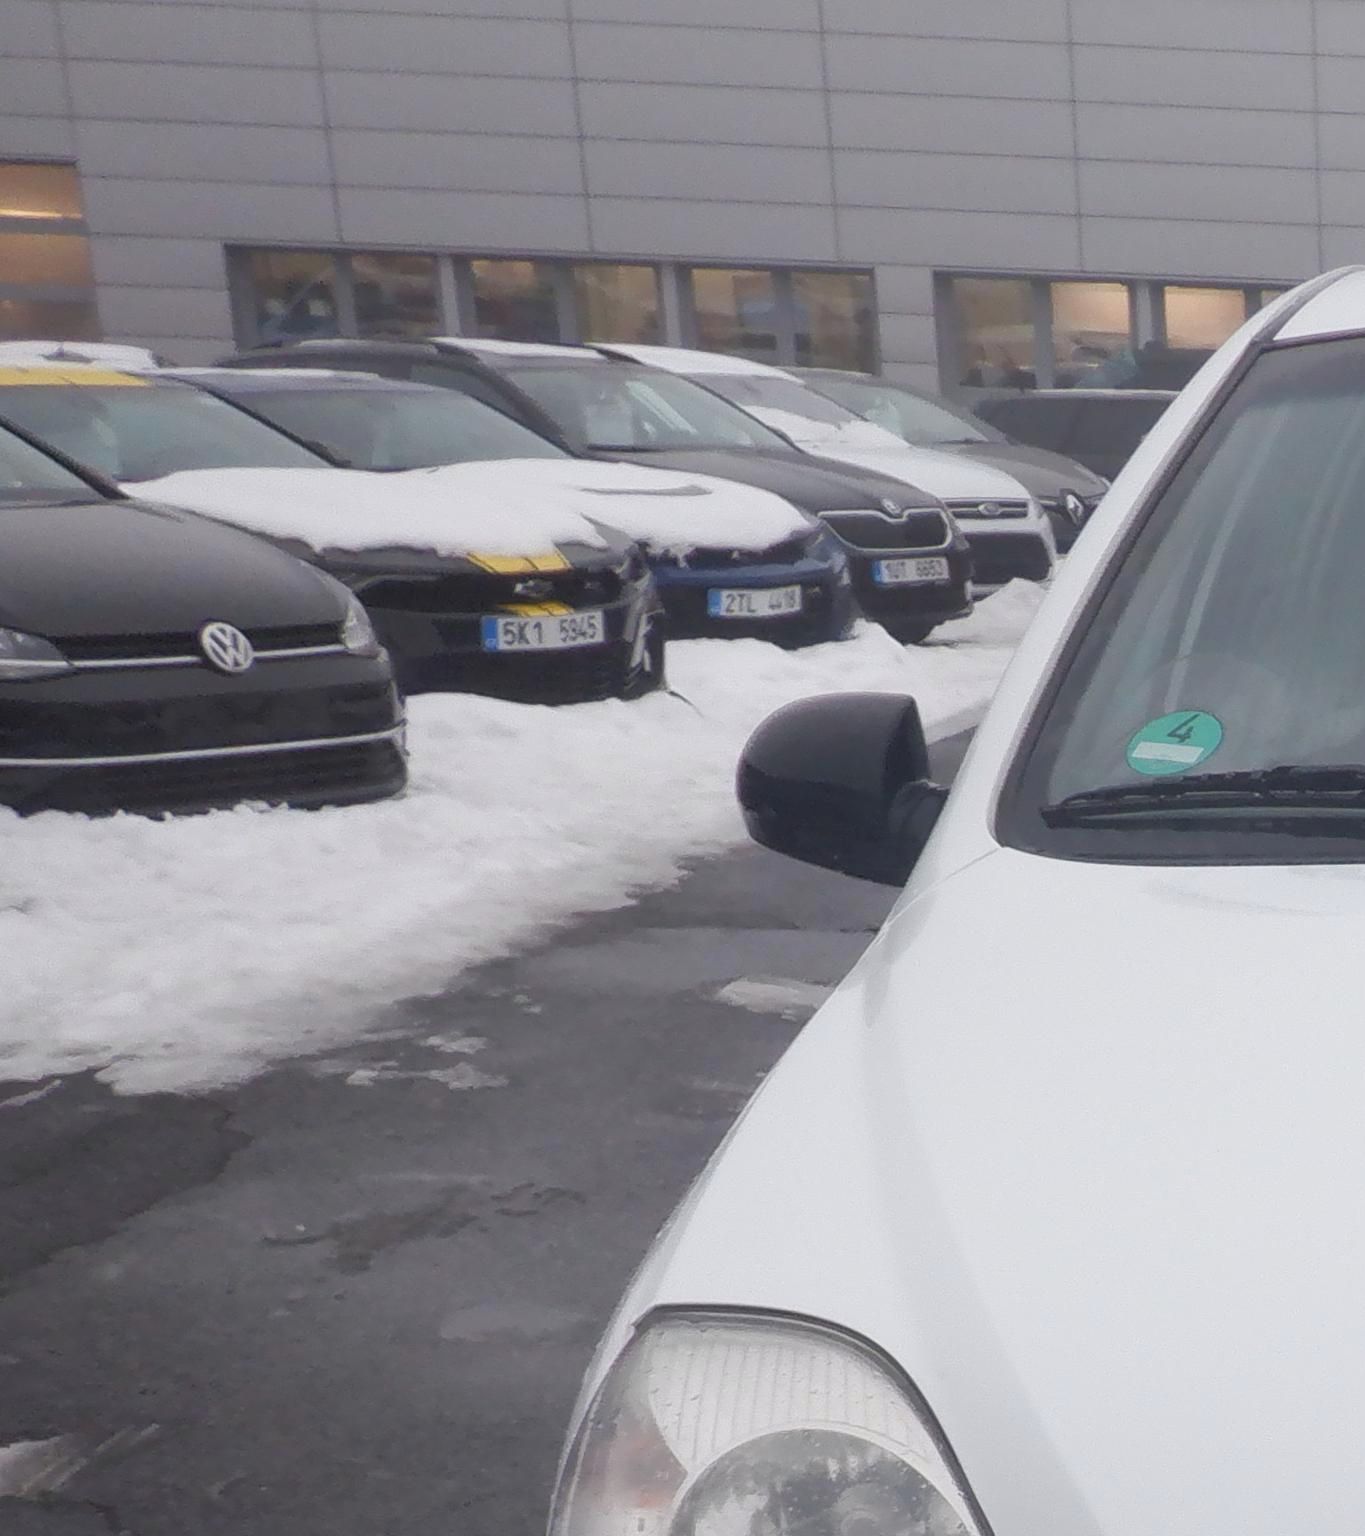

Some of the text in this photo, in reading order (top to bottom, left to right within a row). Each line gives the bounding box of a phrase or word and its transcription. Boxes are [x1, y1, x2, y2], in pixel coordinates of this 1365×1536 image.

[725, 593, 757, 613] 2TL
[502, 621, 544, 646] 5K1
[1166, 713, 1200, 744] 4
